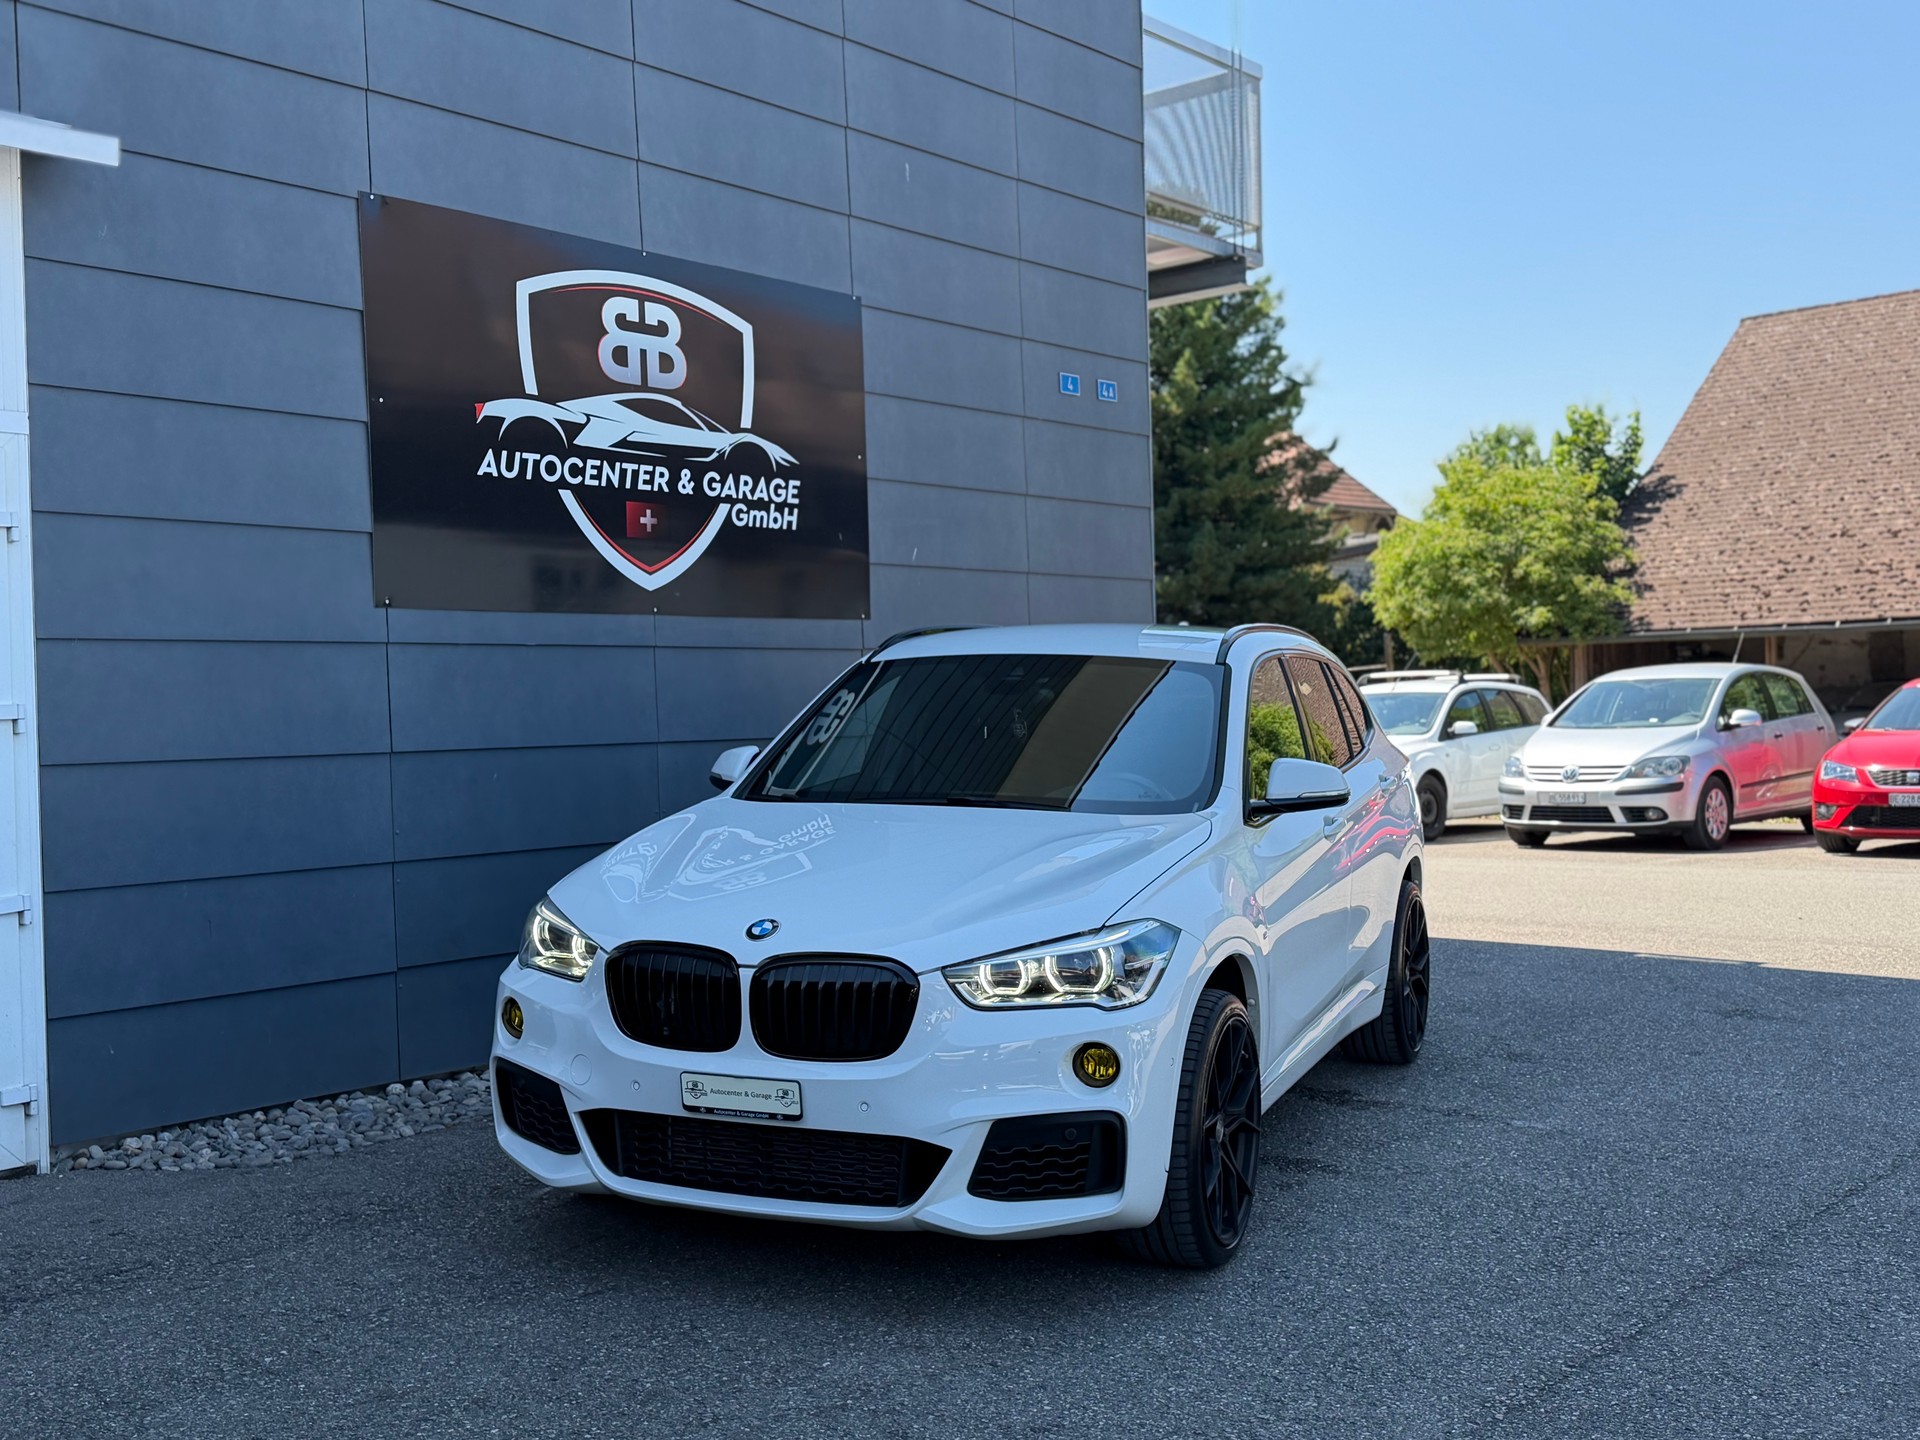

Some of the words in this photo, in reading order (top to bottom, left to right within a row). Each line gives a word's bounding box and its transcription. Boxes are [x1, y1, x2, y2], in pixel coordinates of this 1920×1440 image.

[1067, 376, 1074, 391] 4
[1102, 383, 1115, 398] 4A
[477, 448, 669, 493] AUTOCENTER
[678, 468, 695, 495] &
[702, 471, 801, 504] GARAGE
[731, 503, 799, 531] GmbH
[710, 1088, 742, 1097] Autocenter
[751, 1091, 772, 1100] Garage
